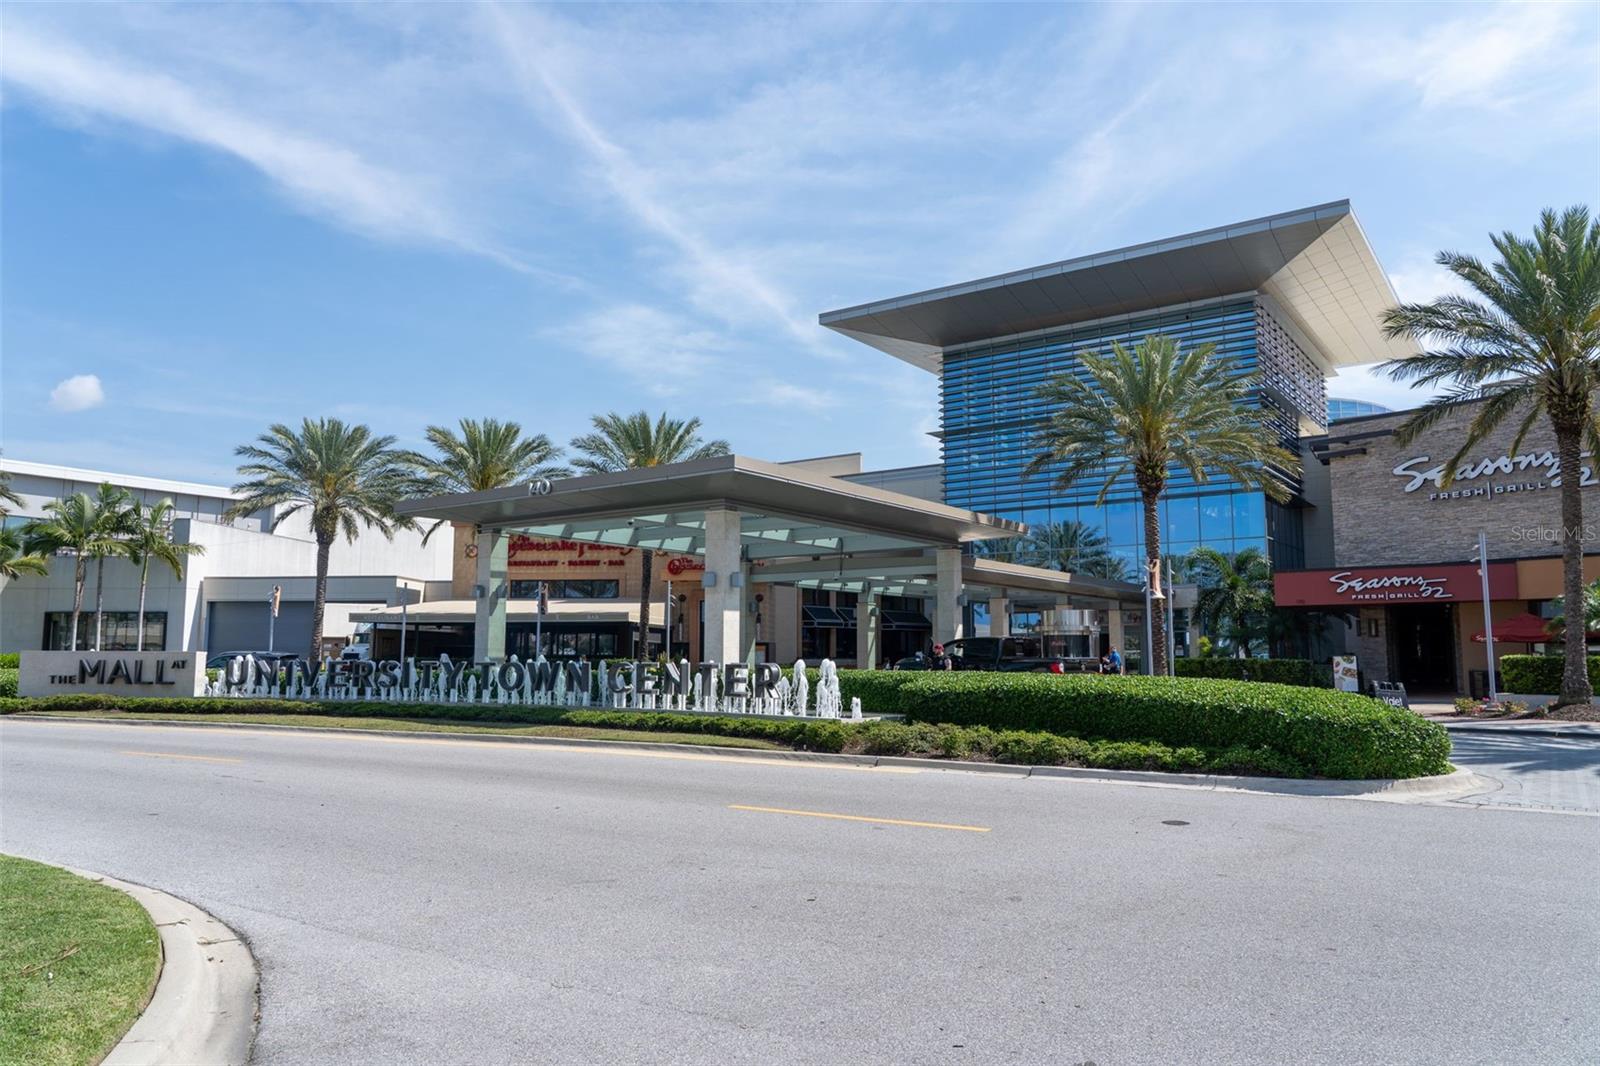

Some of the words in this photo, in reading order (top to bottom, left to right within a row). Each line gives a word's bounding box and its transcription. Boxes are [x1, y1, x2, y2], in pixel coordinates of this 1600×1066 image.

[1393, 451, 1591, 493] Seasons
[1430, 488, 1484, 501] FRESH
[1494, 481, 1546, 494] GRILL
[1329, 572, 1447, 593] Seasons
[1420, 583, 1453, 598] 52
[49, 674, 77, 685] THE
[78, 659, 176, 685] MALL
[171, 660, 188, 669] AT
[225, 659, 467, 689] UNIVERSITY
[475, 661, 592, 693] TOWN
[607, 661, 783, 699] CENTER
